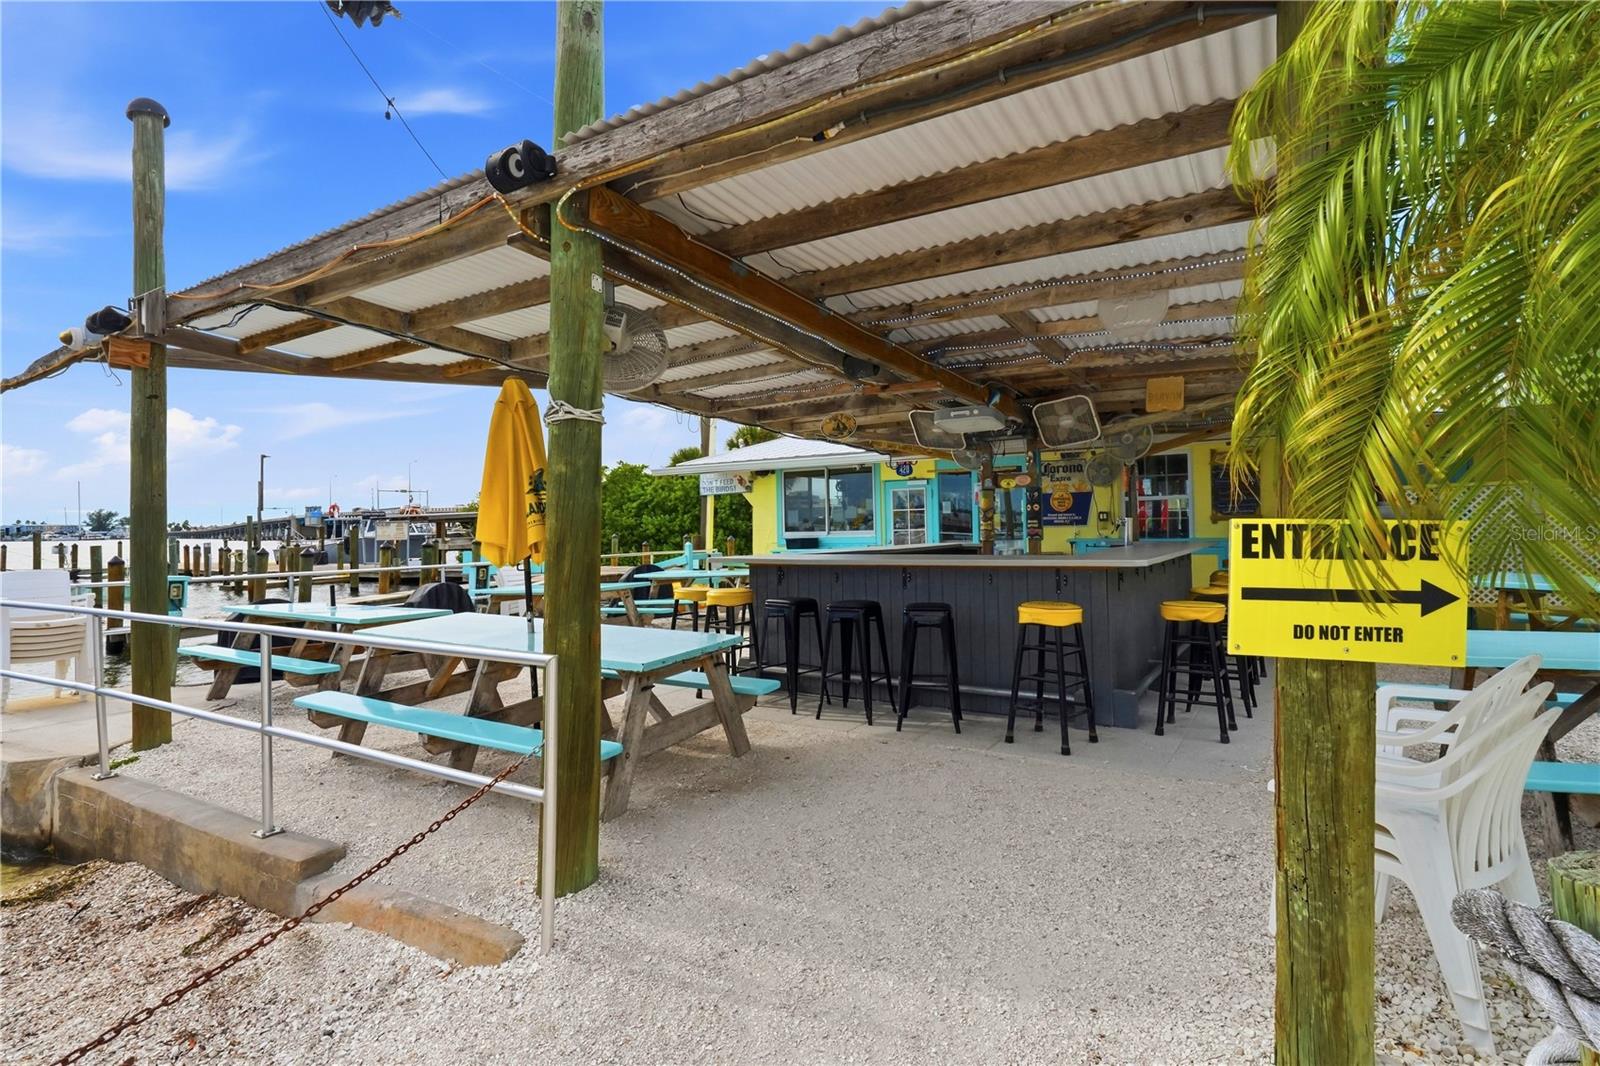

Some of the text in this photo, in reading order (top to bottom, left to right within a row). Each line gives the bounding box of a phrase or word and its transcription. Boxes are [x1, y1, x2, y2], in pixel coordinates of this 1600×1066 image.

[1041, 462, 1083, 476] Corona
[1293, 624, 1404, 643] DO NOT ENTER
